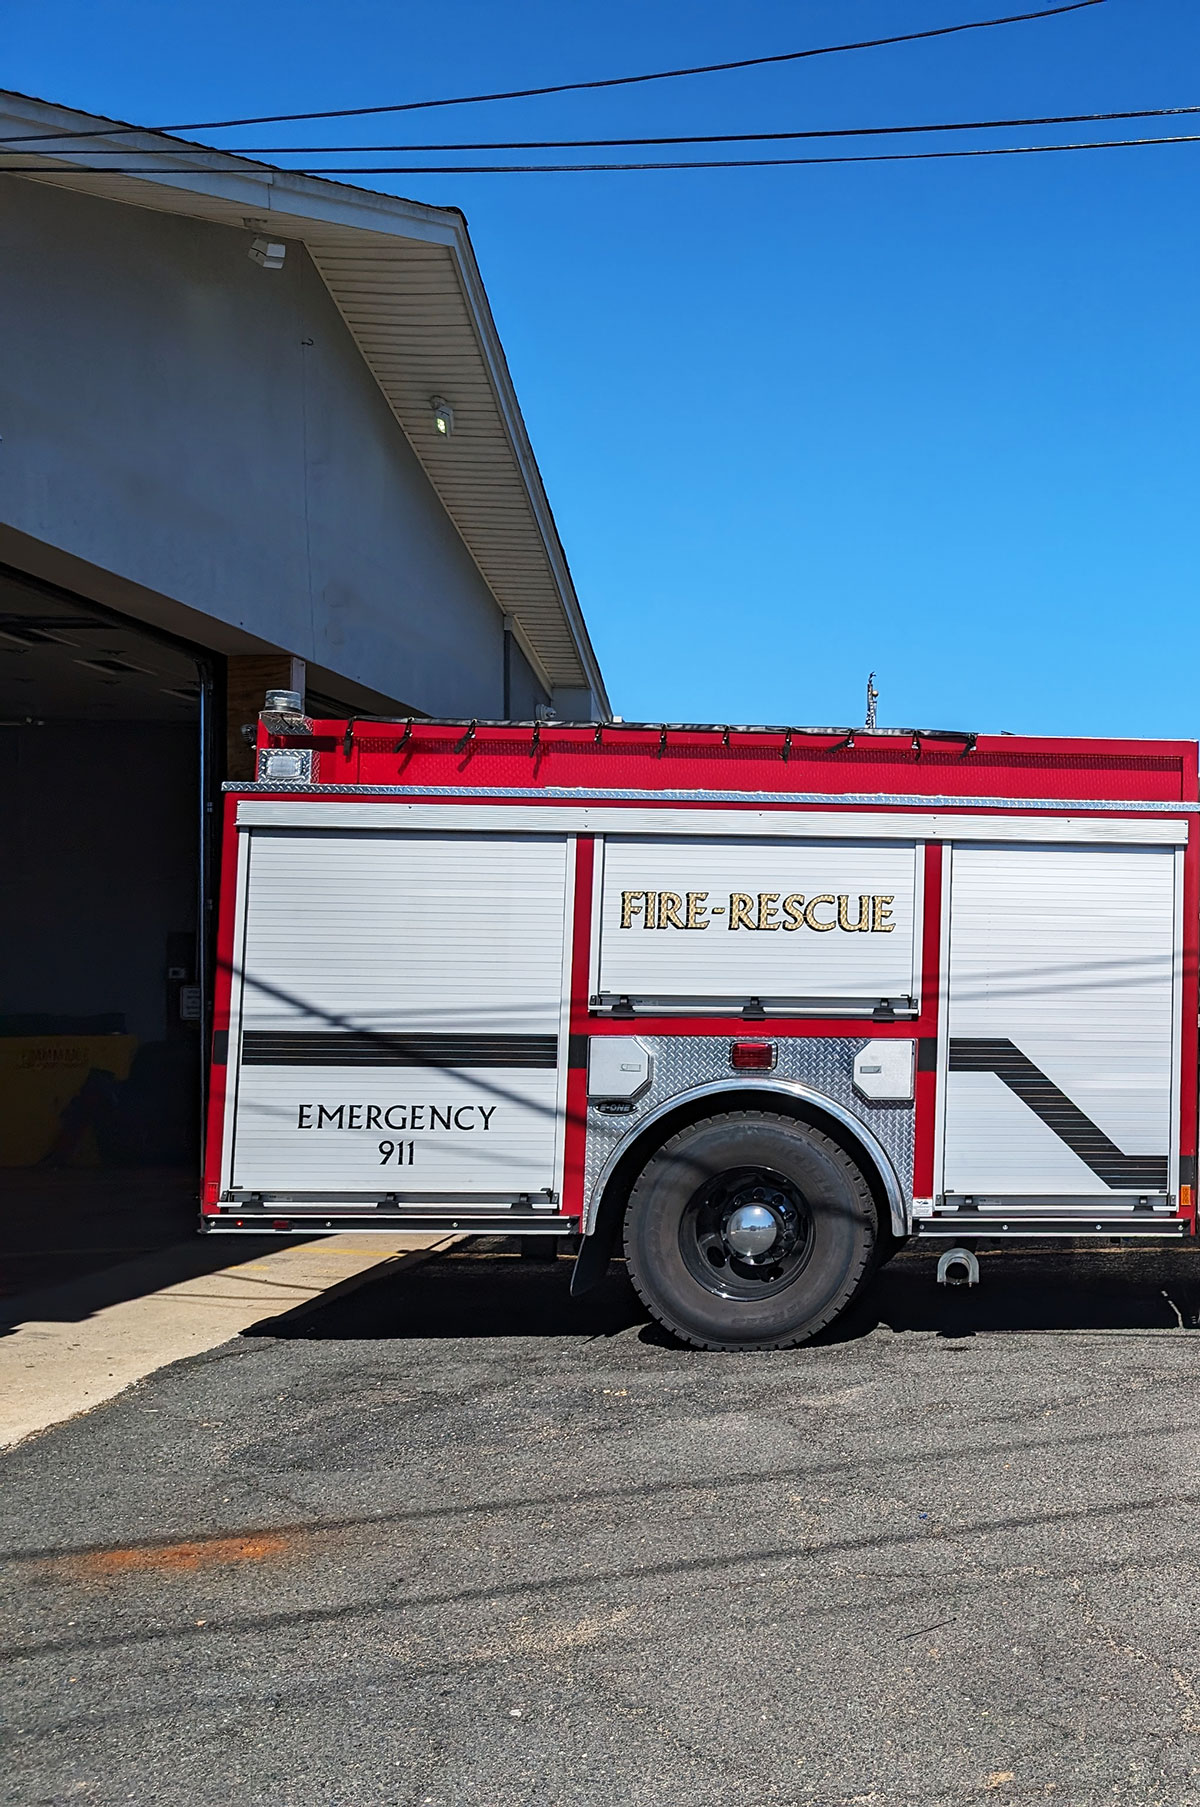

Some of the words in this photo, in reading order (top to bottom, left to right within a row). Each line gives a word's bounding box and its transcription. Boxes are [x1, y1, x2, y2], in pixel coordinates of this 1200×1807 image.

[620, 890, 896, 934] FIRE-RESCUE
[297, 1103, 498, 1131] EMERGENCY
[599, 1103, 632, 1112] E-ONE
[378, 1139, 415, 1167] 911
